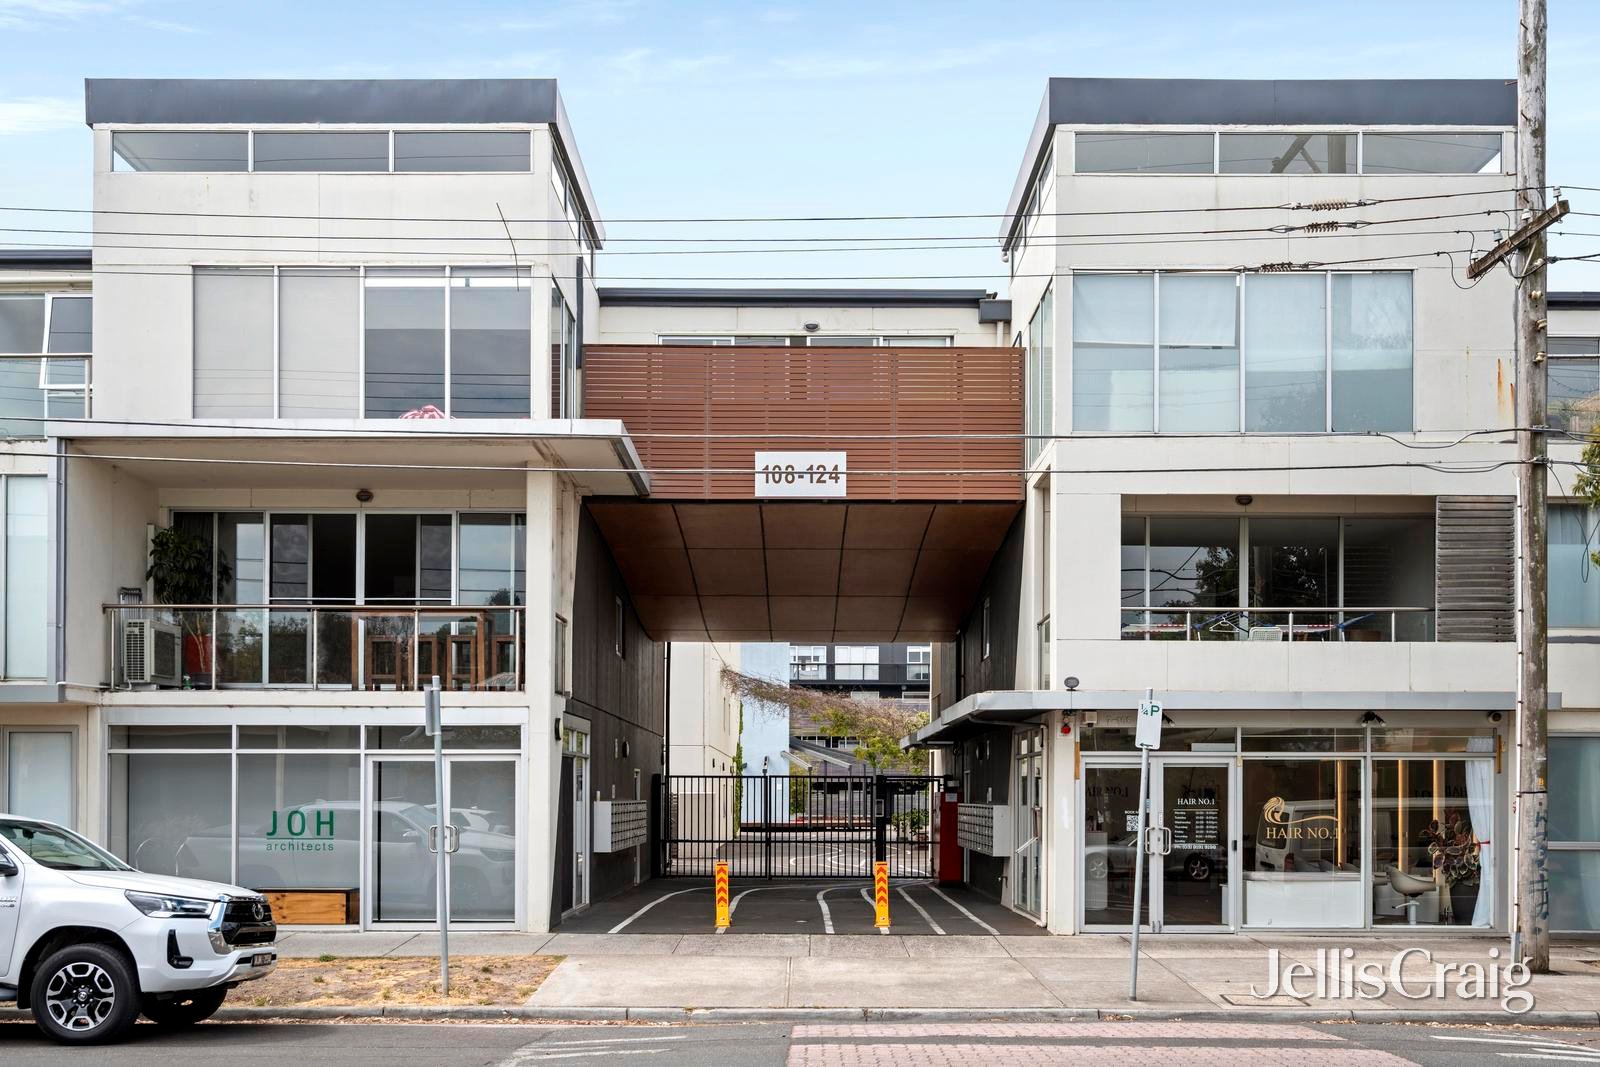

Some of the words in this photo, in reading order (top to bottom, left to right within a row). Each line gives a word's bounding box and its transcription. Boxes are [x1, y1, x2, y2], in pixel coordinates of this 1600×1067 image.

[762, 464, 840, 484] 108-124
[266, 810, 334, 836] JOH
[1266, 827, 1303, 839] HAIR
[1307, 827, 1339, 839] NO.1
[266, 842, 334, 851] architects
